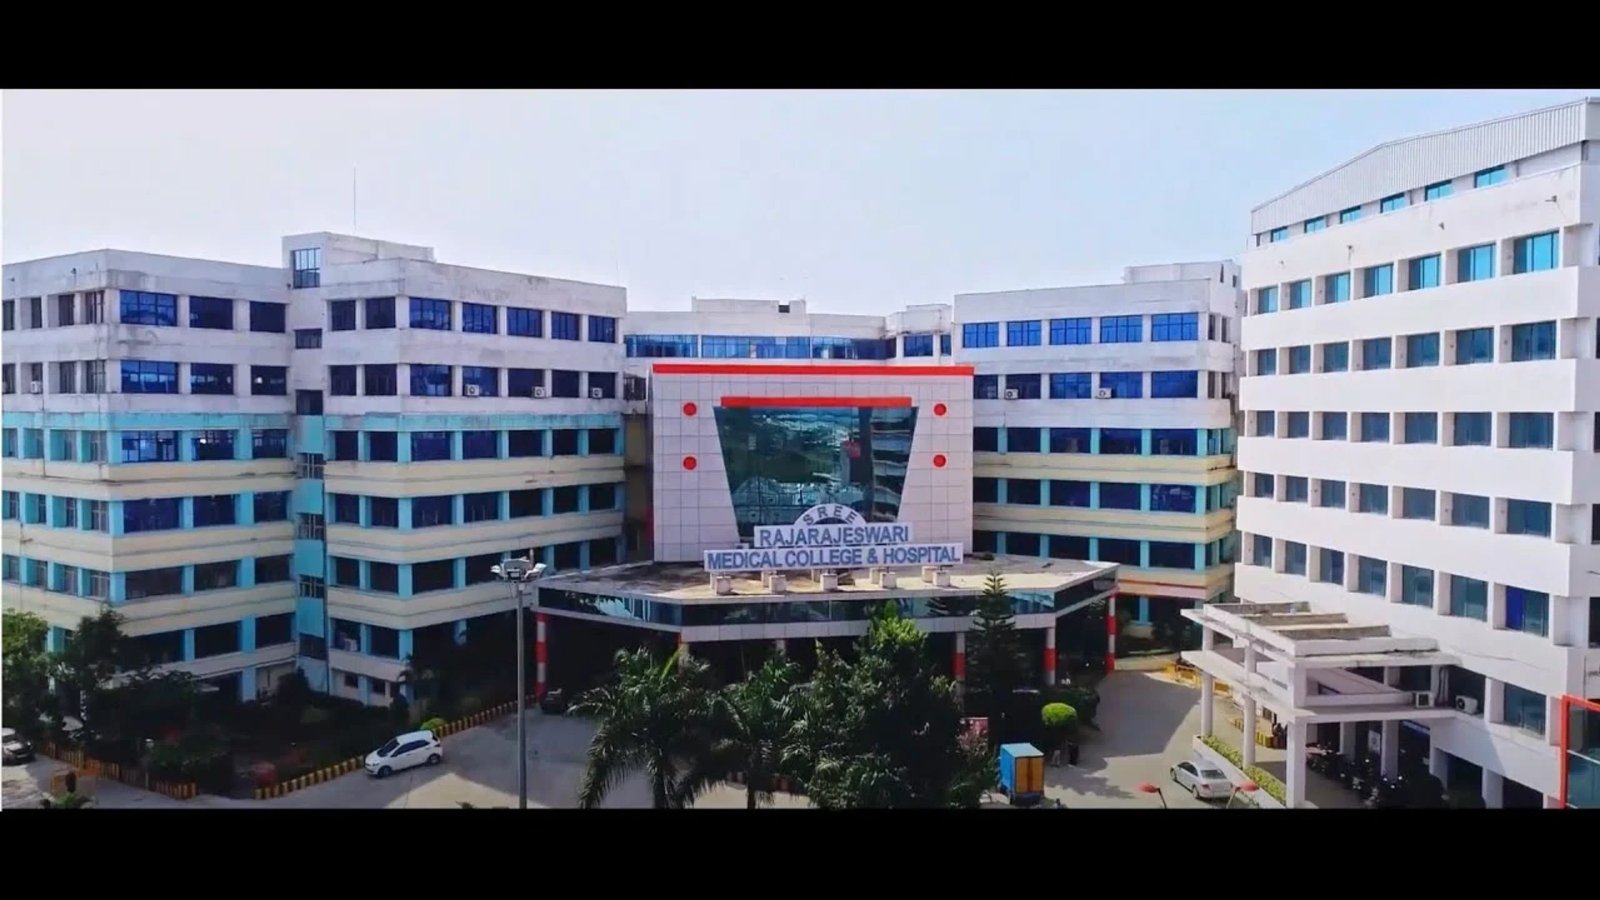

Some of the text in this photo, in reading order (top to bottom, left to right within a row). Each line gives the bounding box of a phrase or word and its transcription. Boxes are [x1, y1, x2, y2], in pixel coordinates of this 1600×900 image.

[803, 505, 856, 525] SREE
[759, 525, 909, 547] RAJARAJESWARI
[707, 546, 961, 570] MEDICAL COLLEGE & HOSPITAL
